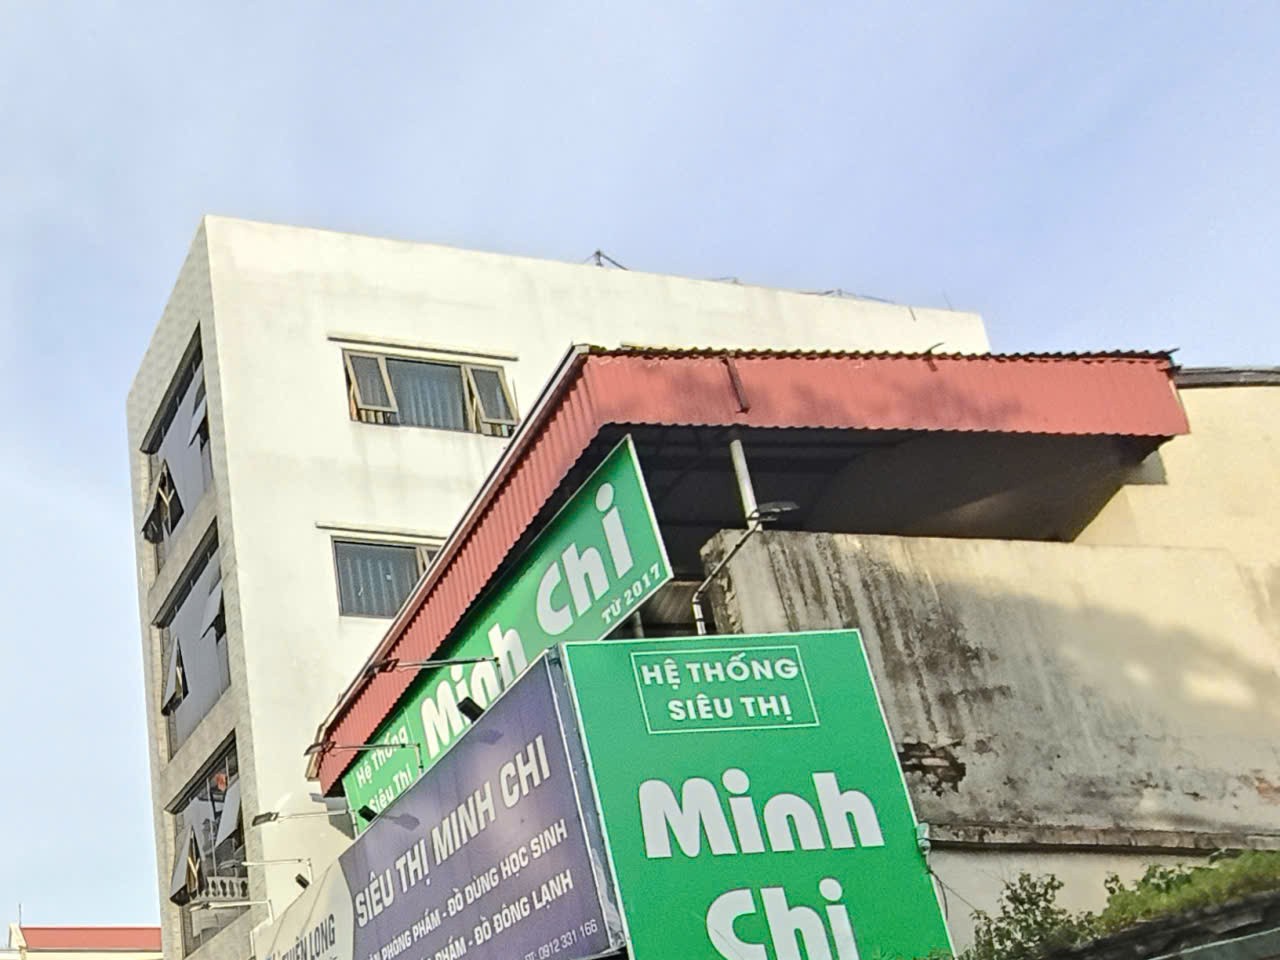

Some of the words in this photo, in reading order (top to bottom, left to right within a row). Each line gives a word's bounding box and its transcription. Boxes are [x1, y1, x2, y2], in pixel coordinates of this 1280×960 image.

[624, 562, 660, 606] 2017
[420, 623, 529, 759] Minh
[536, 482, 634, 636] Chi
[641, 658, 681, 690] HỆ
[687, 652, 799, 684] THỐNG
[668, 694, 734, 722] SIÊU
[739, 695, 792, 722] THỊ
[355, 871, 395, 927] SIÊU
[395, 839, 430, 894] THỊ
[431, 788, 496, 866] MINH
[500, 735, 552, 809] CHI
[637, 768, 885, 859] Minh
[464, 867, 499, 905] DÙNG
[500, 846, 529, 880] HỌC
[530, 818, 569, 859] SINH
[493, 896, 531, 935] ĐÔNG
[532, 869, 574, 910] LẠNH
[538, 941, 560, 960] 0912
[561, 930, 578, 950] 331
[580, 919, 598, 939] 166
